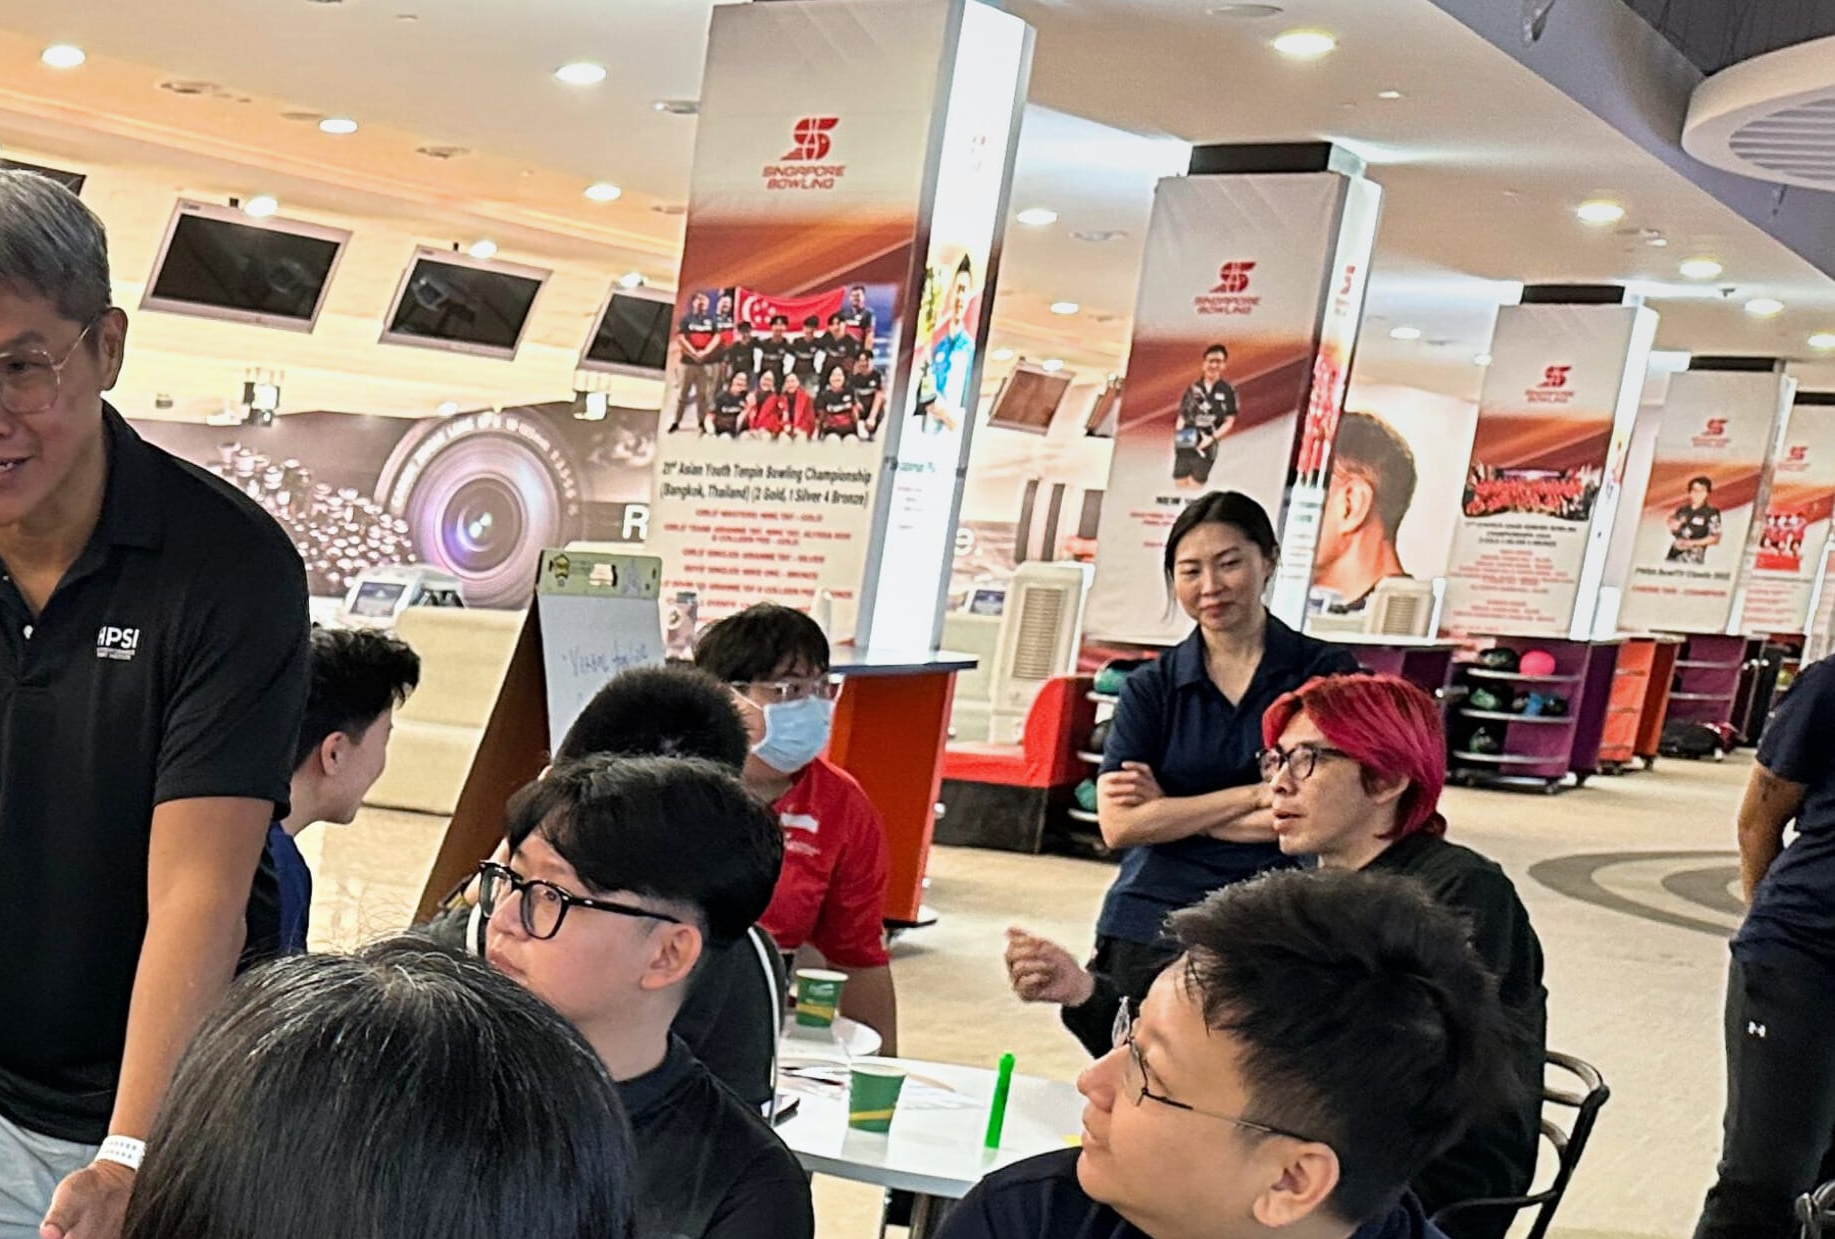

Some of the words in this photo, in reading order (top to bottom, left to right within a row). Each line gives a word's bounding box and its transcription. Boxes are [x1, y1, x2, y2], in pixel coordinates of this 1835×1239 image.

[762, 165, 846, 177] SINGAPORE
[766, 178, 835, 189] BOWLING
[622, 504, 650, 540] R
[954, 527, 982, 556] e.
[97, 626, 140, 649] HPSI
